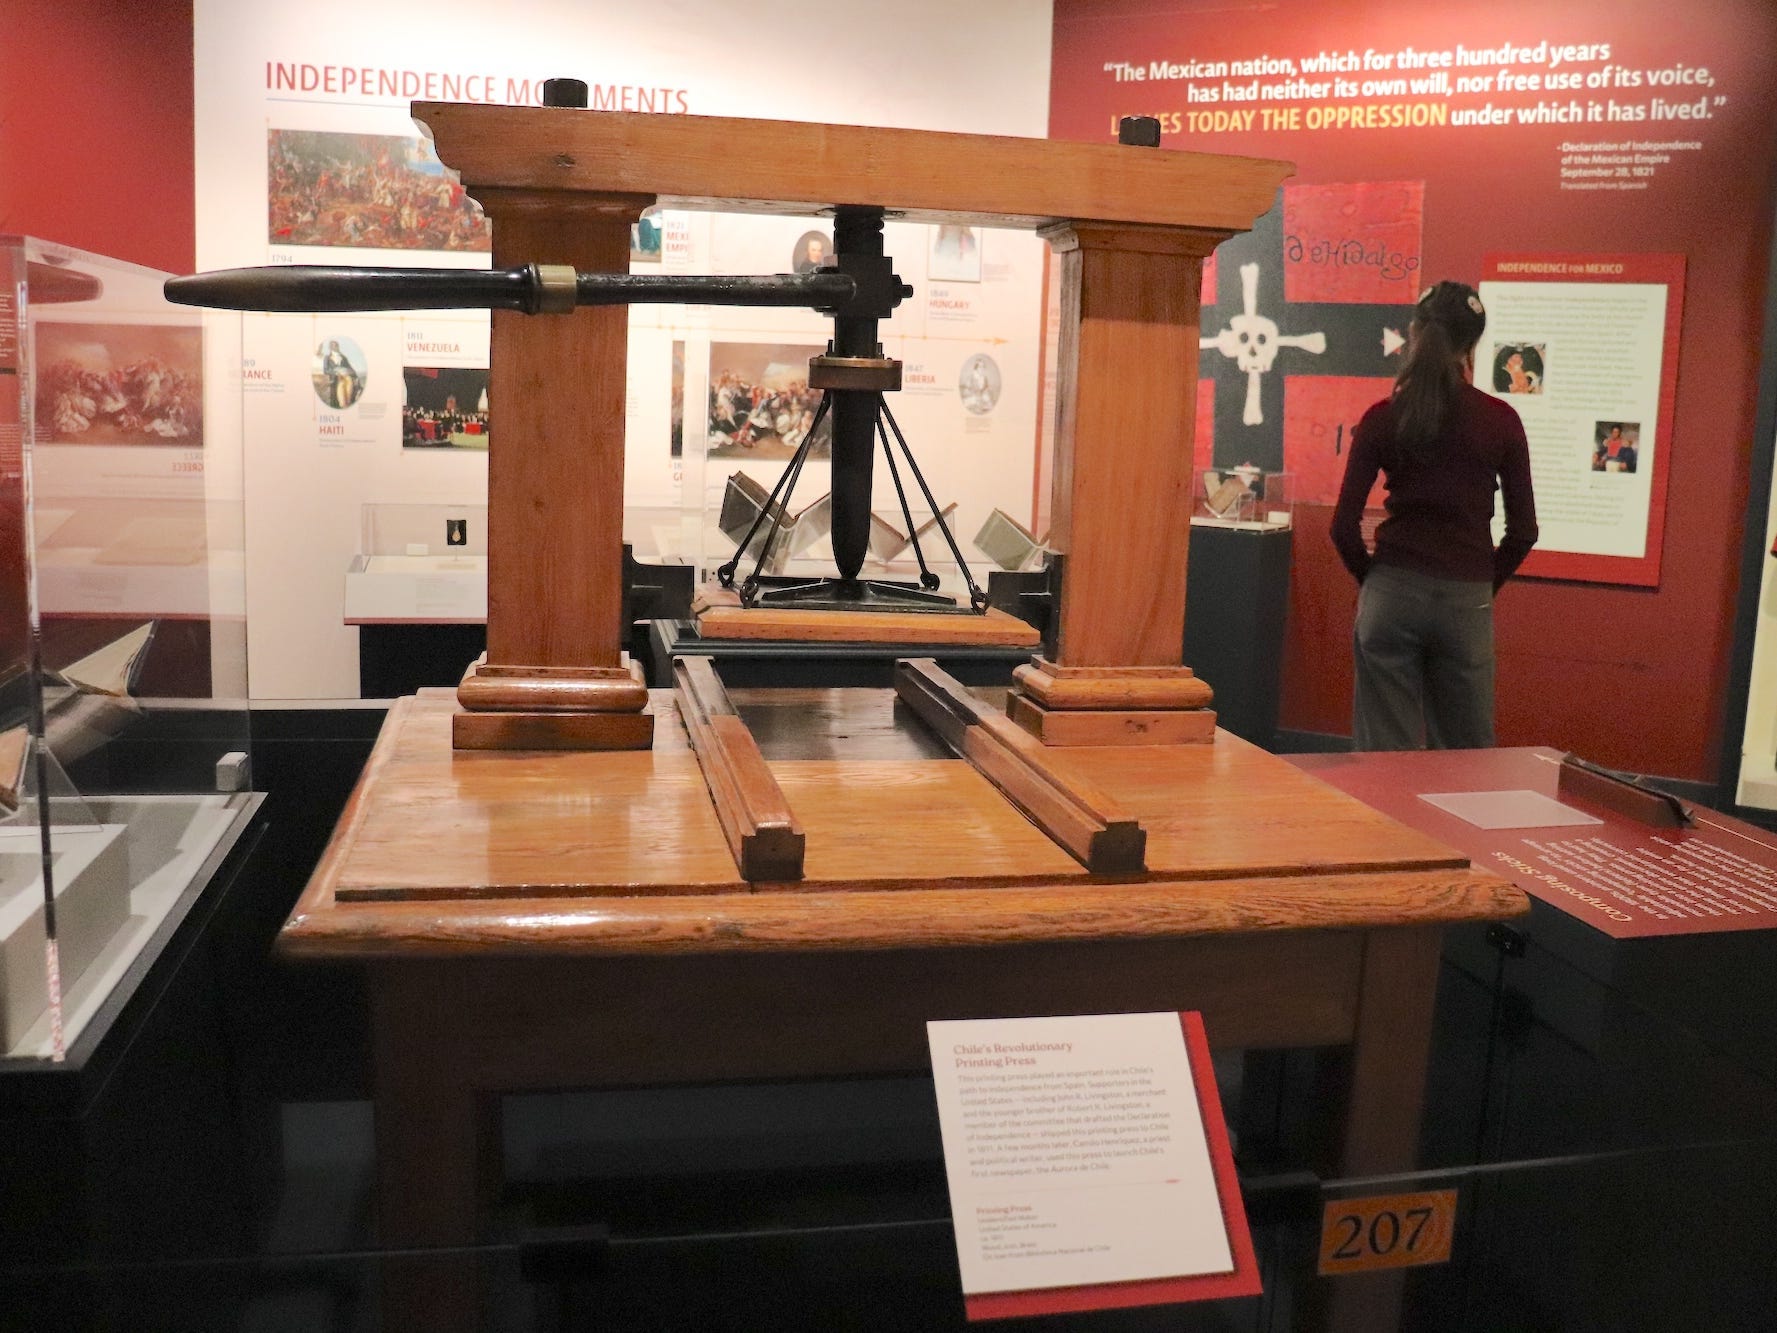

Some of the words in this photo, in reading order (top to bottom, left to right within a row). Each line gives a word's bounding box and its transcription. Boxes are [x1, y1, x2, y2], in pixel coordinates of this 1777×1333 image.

[1149, 59, 1227, 80] Mexican
[1231, 56, 1298, 77] nation,
[1300, 50, 1360, 74] which
[1363, 48, 1394, 71] for
[1396, 47, 1453, 69] three
[1456, 41, 1546, 67] hundred
[1549, 43, 1611, 69] years
[266, 61, 496, 102] INDEPENDENCE
[506, 78, 688, 114] MOMENTS
[1187, 82, 1219, 103] has
[1223, 79, 1259, 102] had
[1261, 78, 1331, 101] neither
[1334, 76, 1359, 97] its
[1361, 79, 1407, 97] own
[1410, 71, 1453, 96] will,
[1456, 75, 1494, 93] nor
[1496, 69, 1540, 92] free
[1545, 72, 1583, 91] use
[1586, 64, 1613, 88] of
[1614, 65, 1642, 88] its
[1647, 63, 1715, 87] voice,
[1110, 112, 1182, 136] LES
[1187, 109, 1257, 134] TODAY
[1260, 107, 1301, 131] THE
[1306, 103, 1447, 130] OPPRESSION
[1451, 103, 1514, 126] under
[1517, 101, 1583, 124] which
[1587, 100, 1603, 123] it
[1607, 99, 1646, 122] has
[1619, 141, 1631, 151] of
[1632, 140, 1703, 152] Independence
[1560, 155, 1573, 165] of
[1574, 155, 1590, 164] the
[1591, 154, 1633, 164] Mexican
[1634, 153, 1670, 165] Empire
[1560, 167, 1614, 178] September
[1497, 262, 1568, 274] INDEPENDENCE
[1585, 263, 1624, 274] MEXICO
[929, 299, 970, 310] HUNGARY
[407, 343, 460, 353] VENEZUELA
[905, 374, 936, 384] LIBERIA
[319, 425, 345, 435] HAITI
[1536, 874, 1633, 923] Composing
[993, 1040, 1072, 1055] Revolutionary
[955, 1057, 1002, 1070] Printing
[1005, 1055, 1036, 1065] Press
[1331, 1207, 1434, 1259] 207
